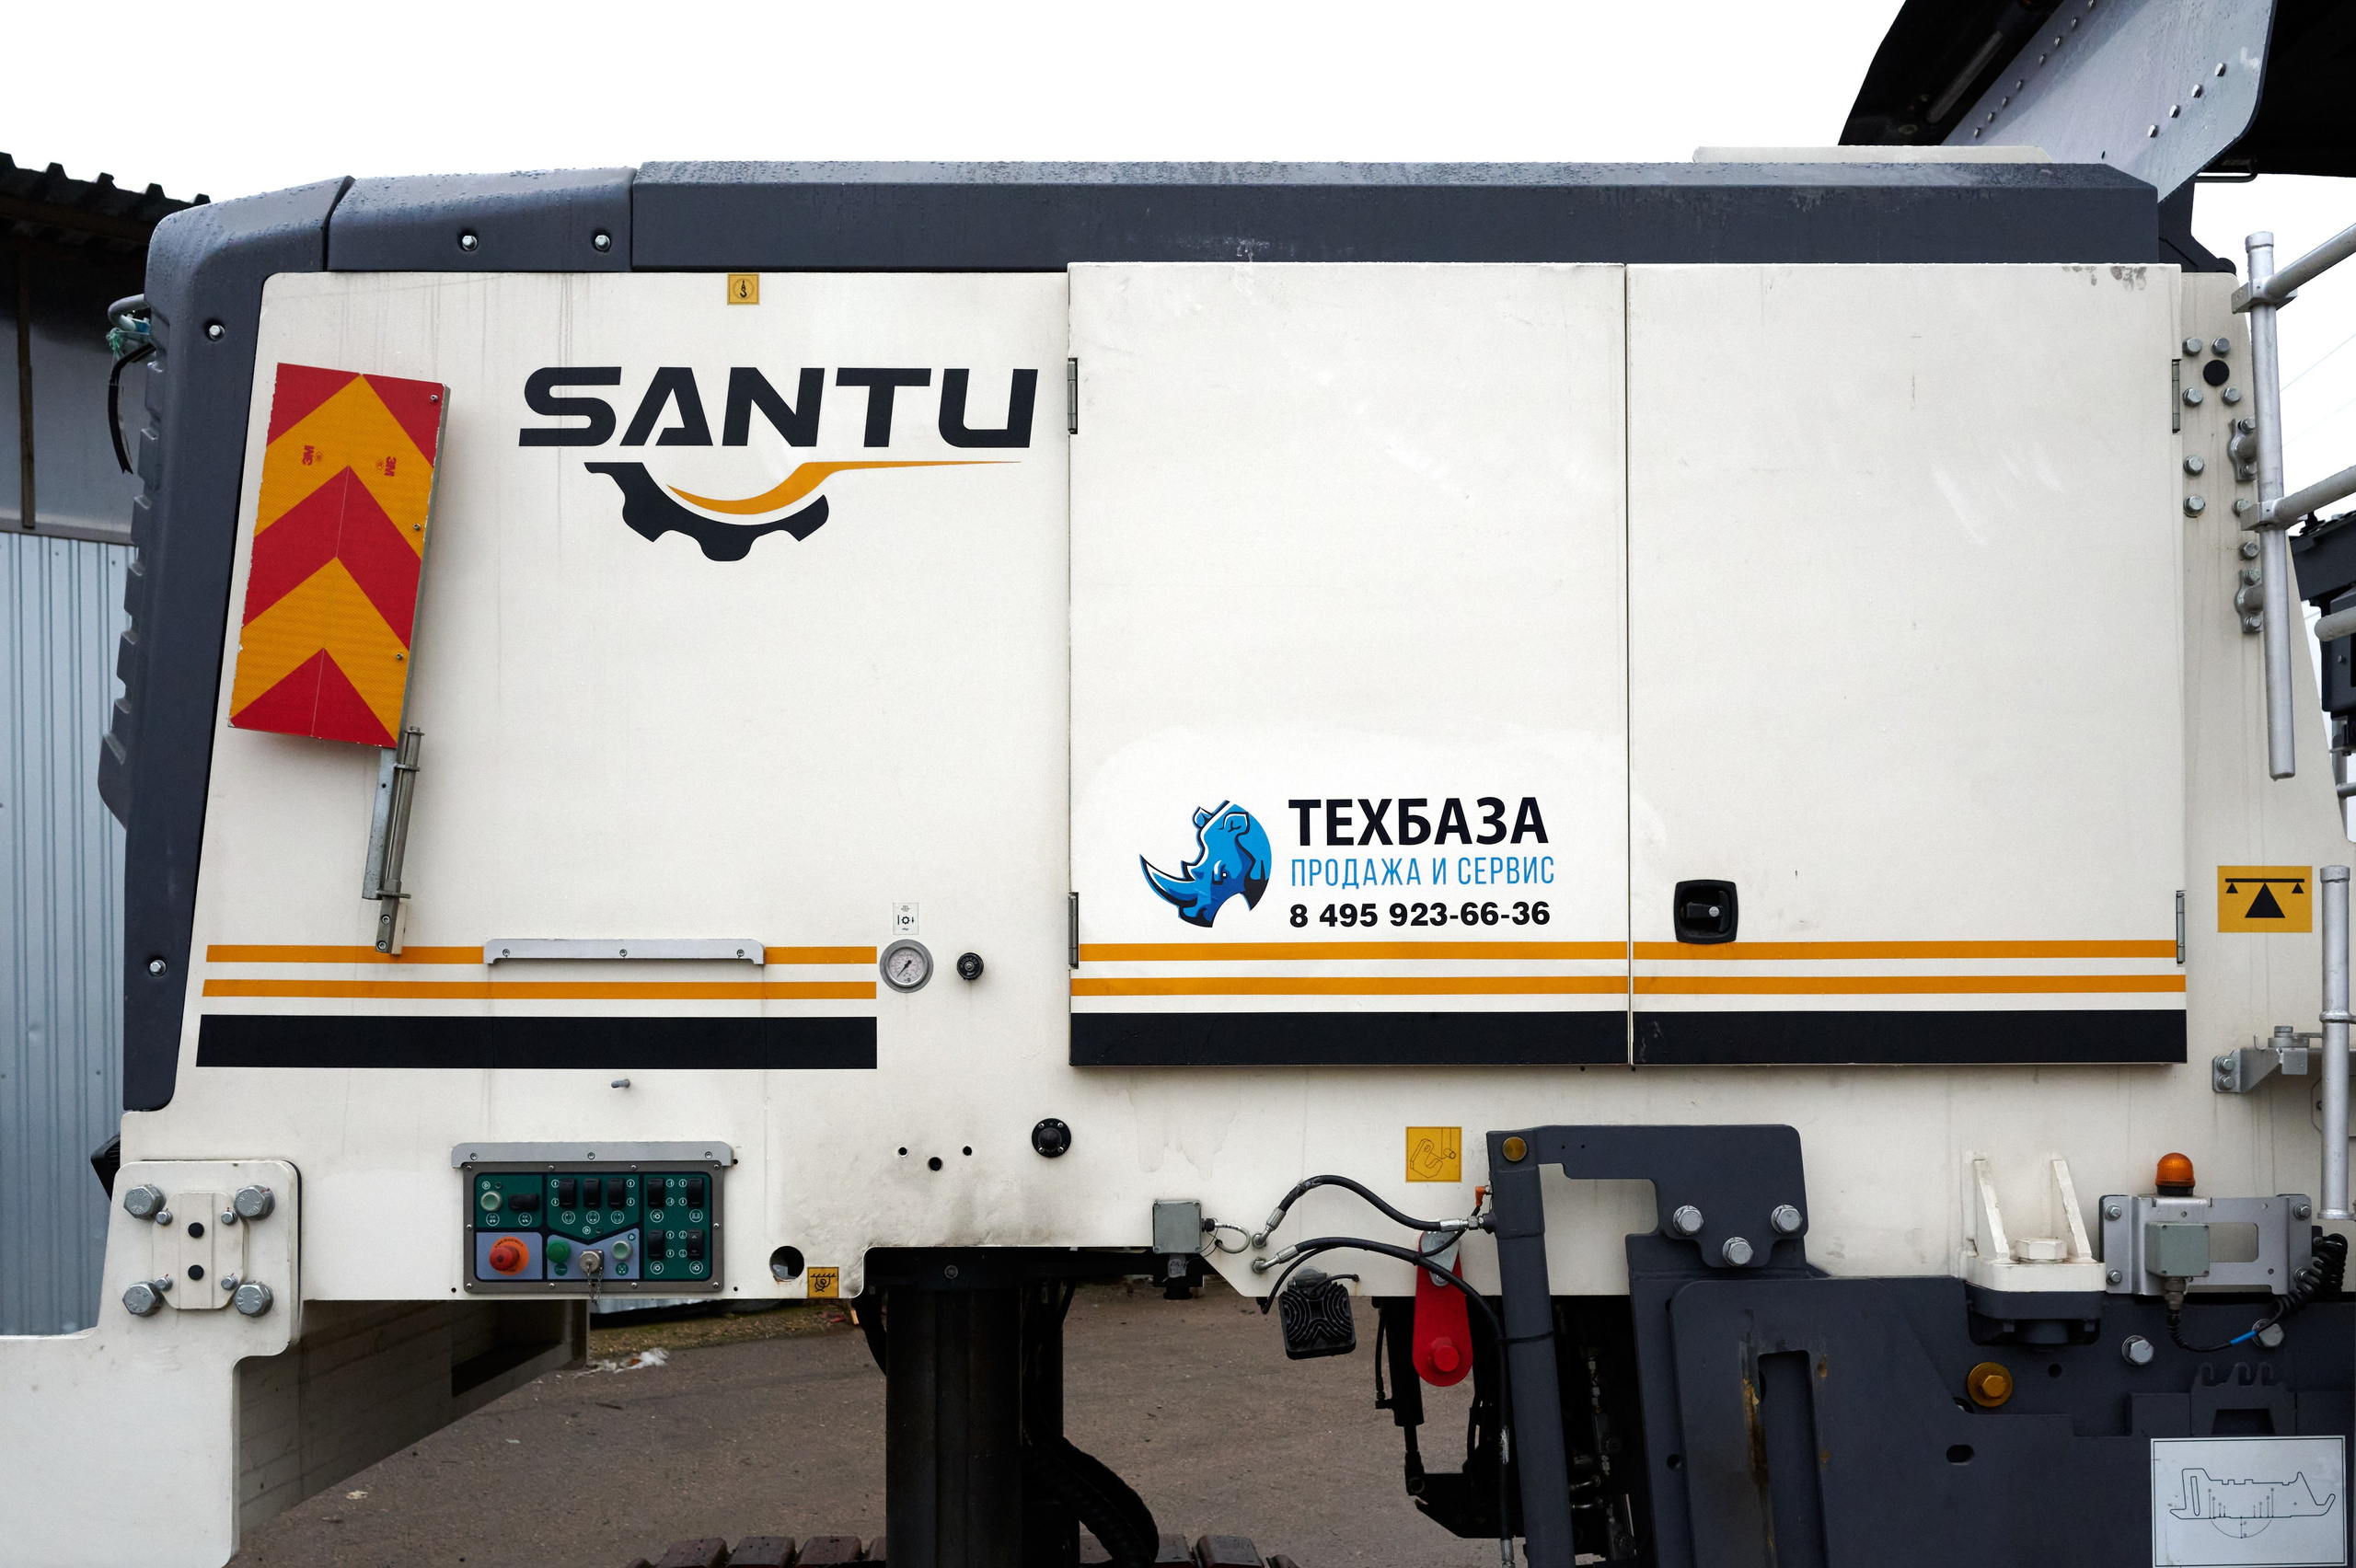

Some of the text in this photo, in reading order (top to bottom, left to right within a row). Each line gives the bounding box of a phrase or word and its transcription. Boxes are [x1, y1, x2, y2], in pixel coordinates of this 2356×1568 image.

[519, 366, 1039, 449] SANTU
[302, 444, 315, 467] 3M
[384, 455, 397, 478] 3M
[1288, 796, 1550, 847] ТЕХБАЗА
[1291, 855, 1554, 890] ПРОДАЖА И СЕРВИС
[1289, 901, 1551, 928] 8 495 923-66-36
